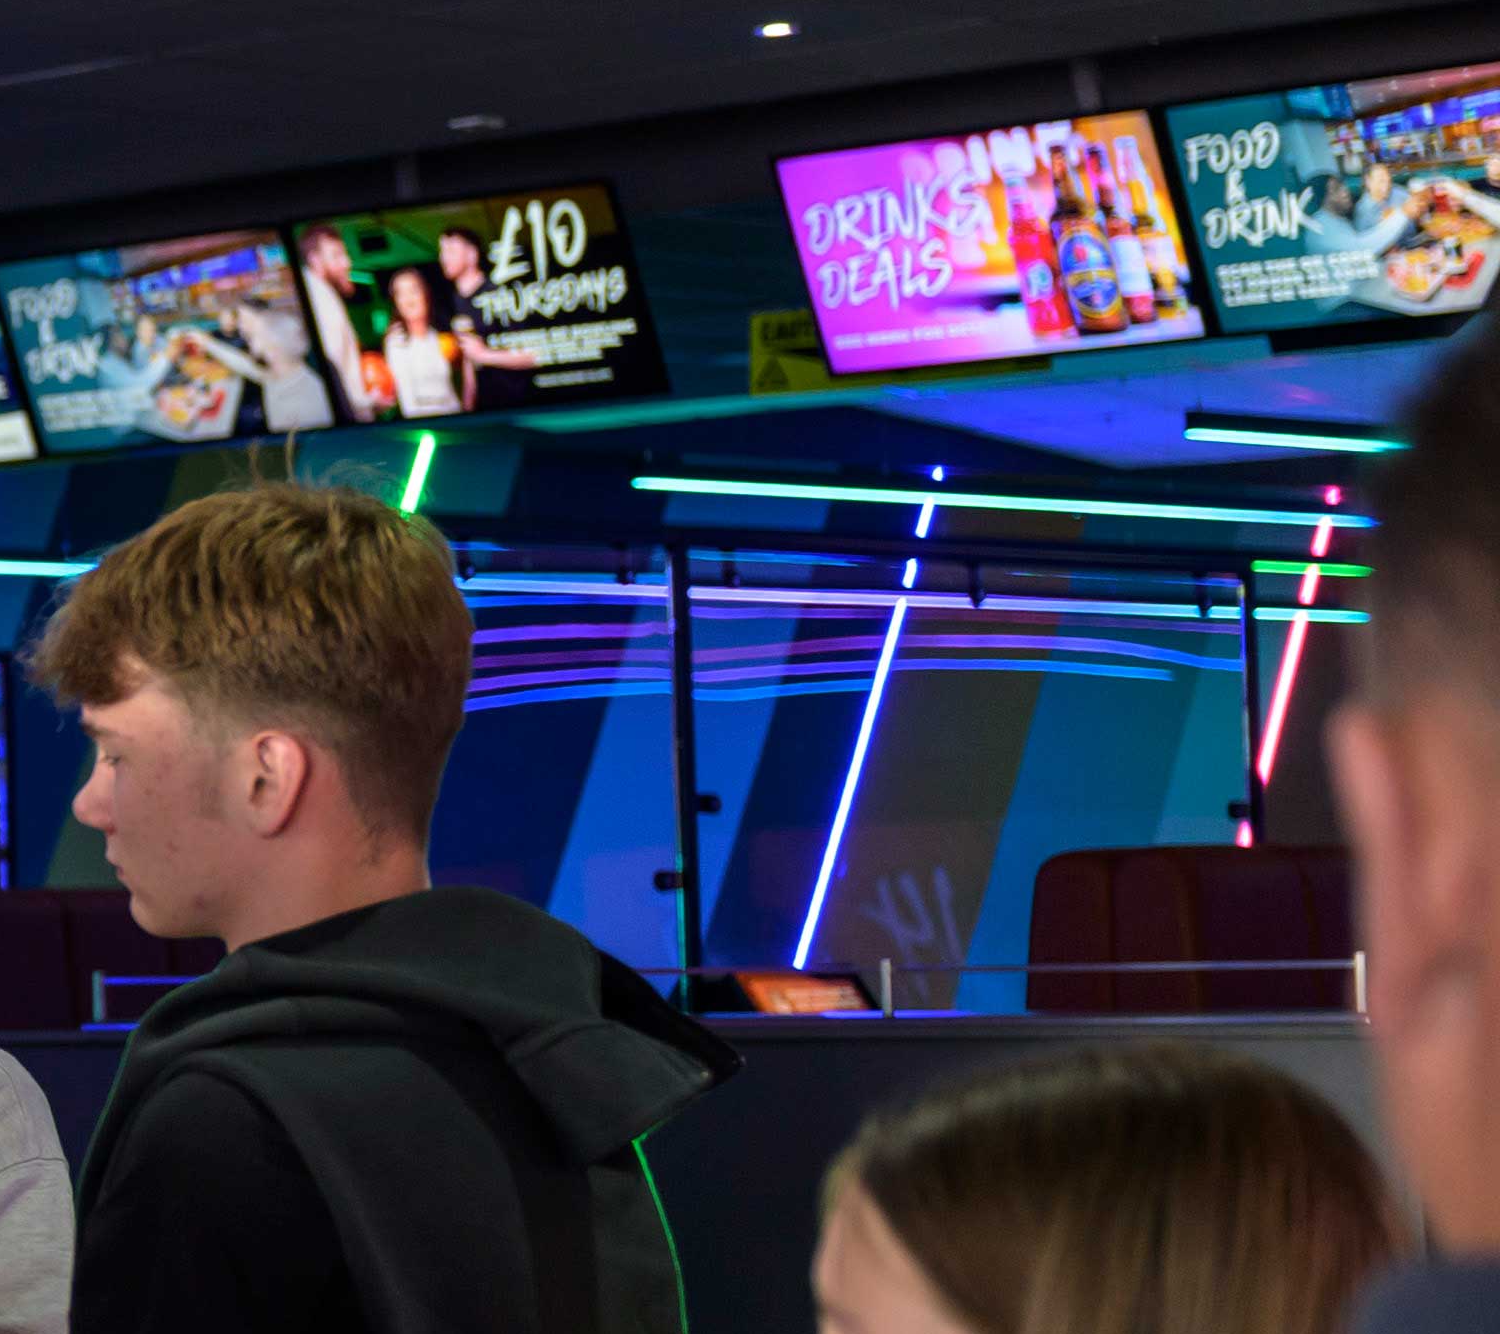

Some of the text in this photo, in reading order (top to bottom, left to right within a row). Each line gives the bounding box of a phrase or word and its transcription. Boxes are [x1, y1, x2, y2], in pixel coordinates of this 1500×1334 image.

[1183, 120, 1282, 184] FOOD
[488, 197, 589, 289] £10
[803, 167, 992, 257] DRINKS
[1202, 185, 1325, 250] DRINK
[470, 265, 629, 328] THURSDAYS
[815, 237, 954, 312] DEALS
